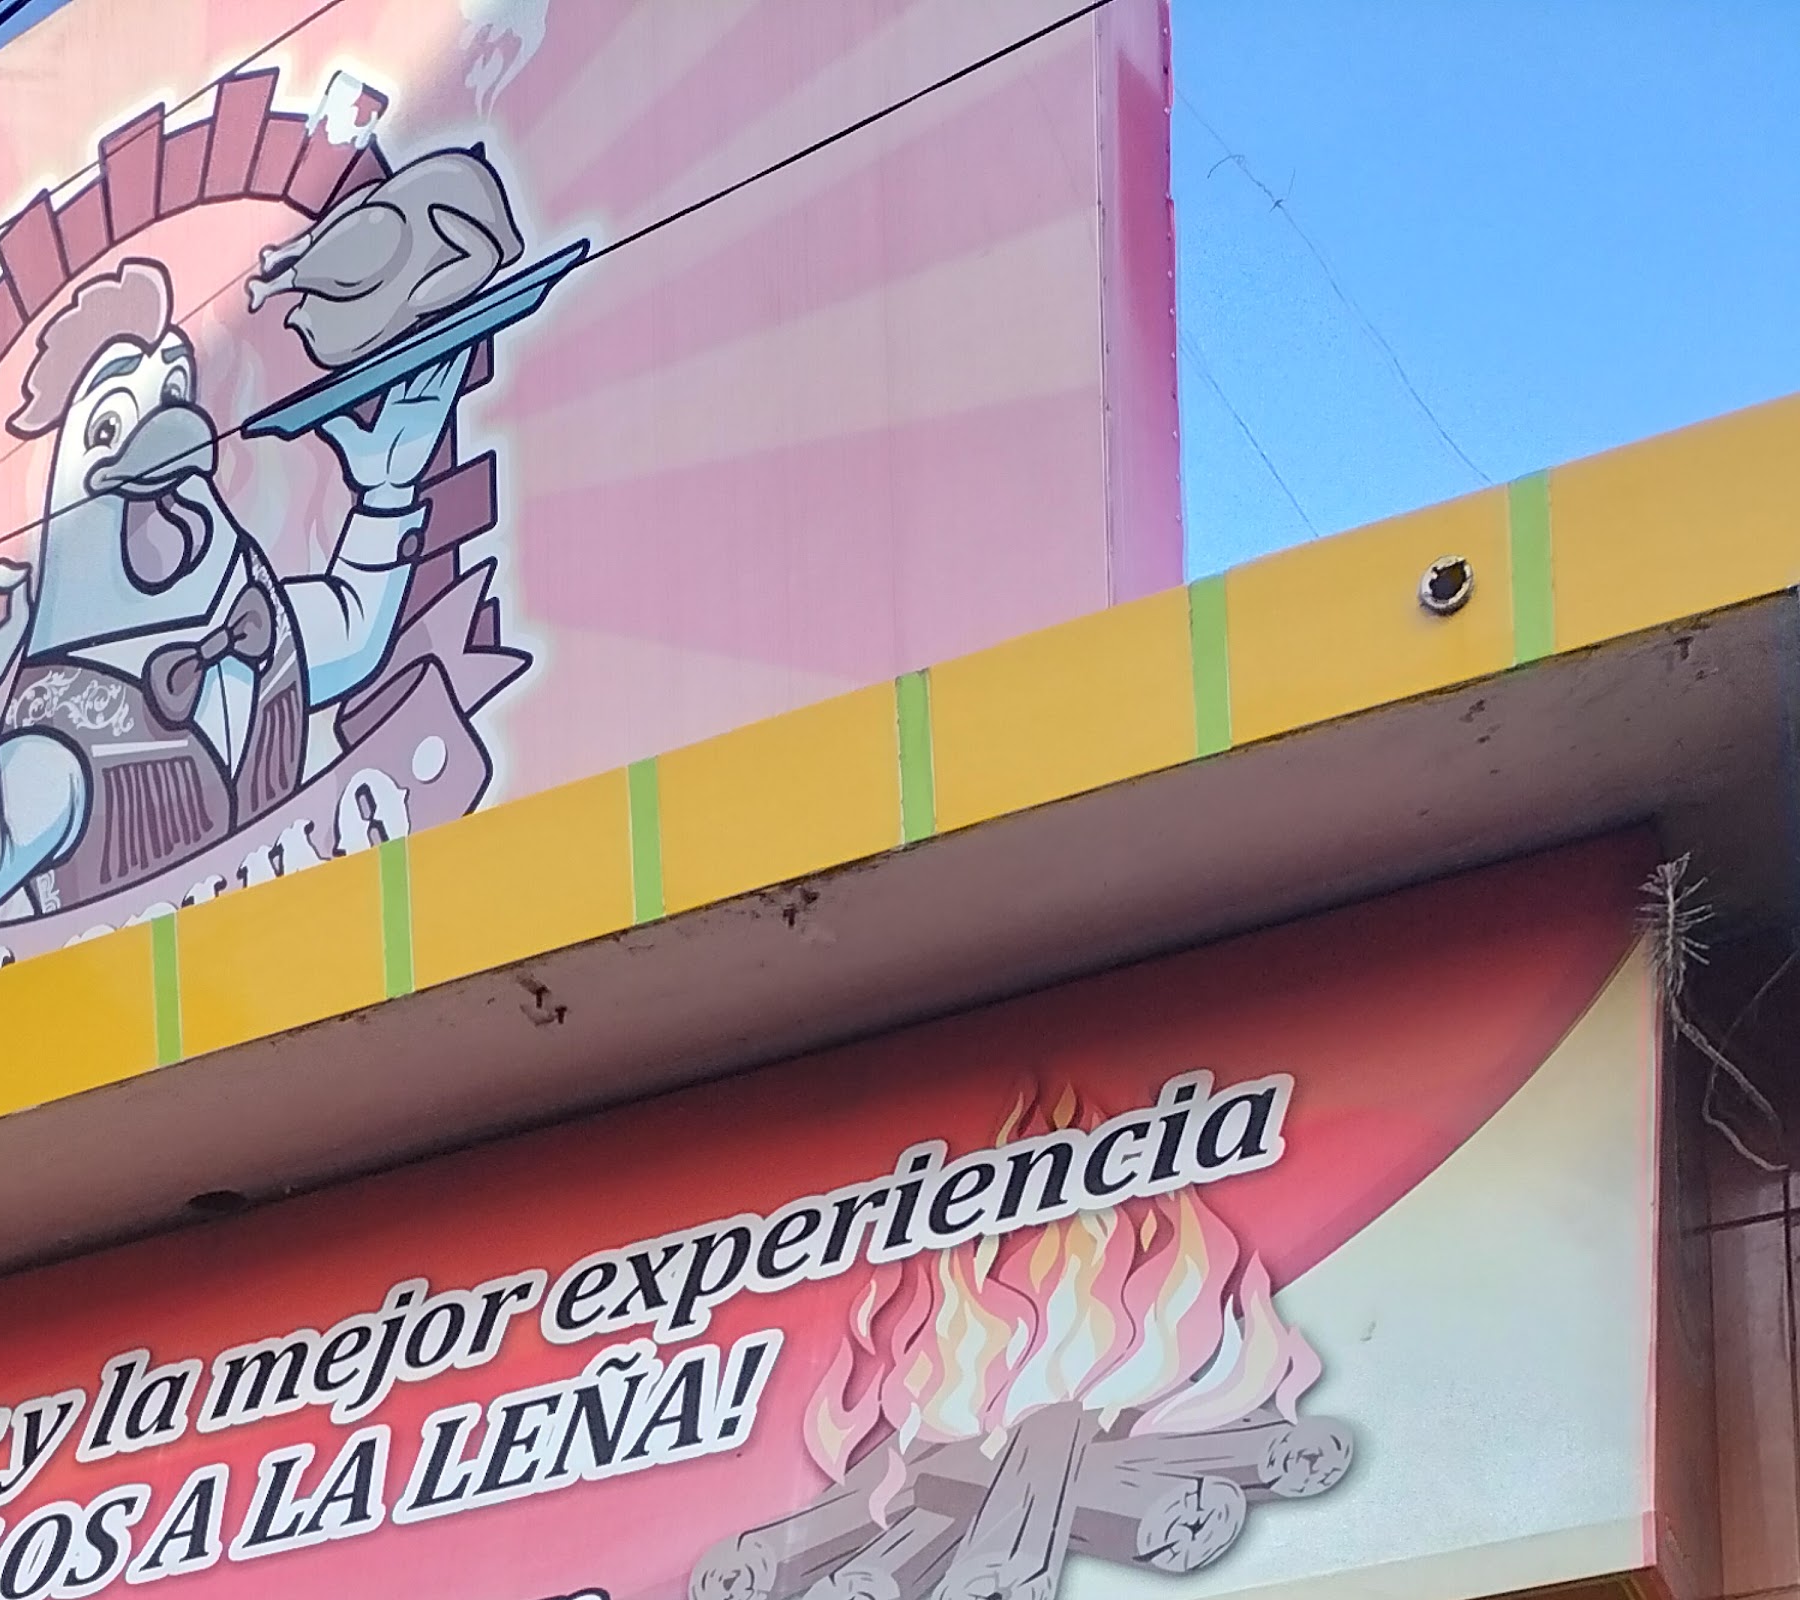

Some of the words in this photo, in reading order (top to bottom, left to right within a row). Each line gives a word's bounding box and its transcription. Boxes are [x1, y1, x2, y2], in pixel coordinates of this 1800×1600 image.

[87, 1359, 192, 1452] la
[209, 1287, 535, 1416] mejor
[553, 1079, 1281, 1331] experiencia
[137, 1475, 221, 1574] A
[240, 1435, 382, 1546] LA
[404, 1343, 770, 1512] LEÑA!
